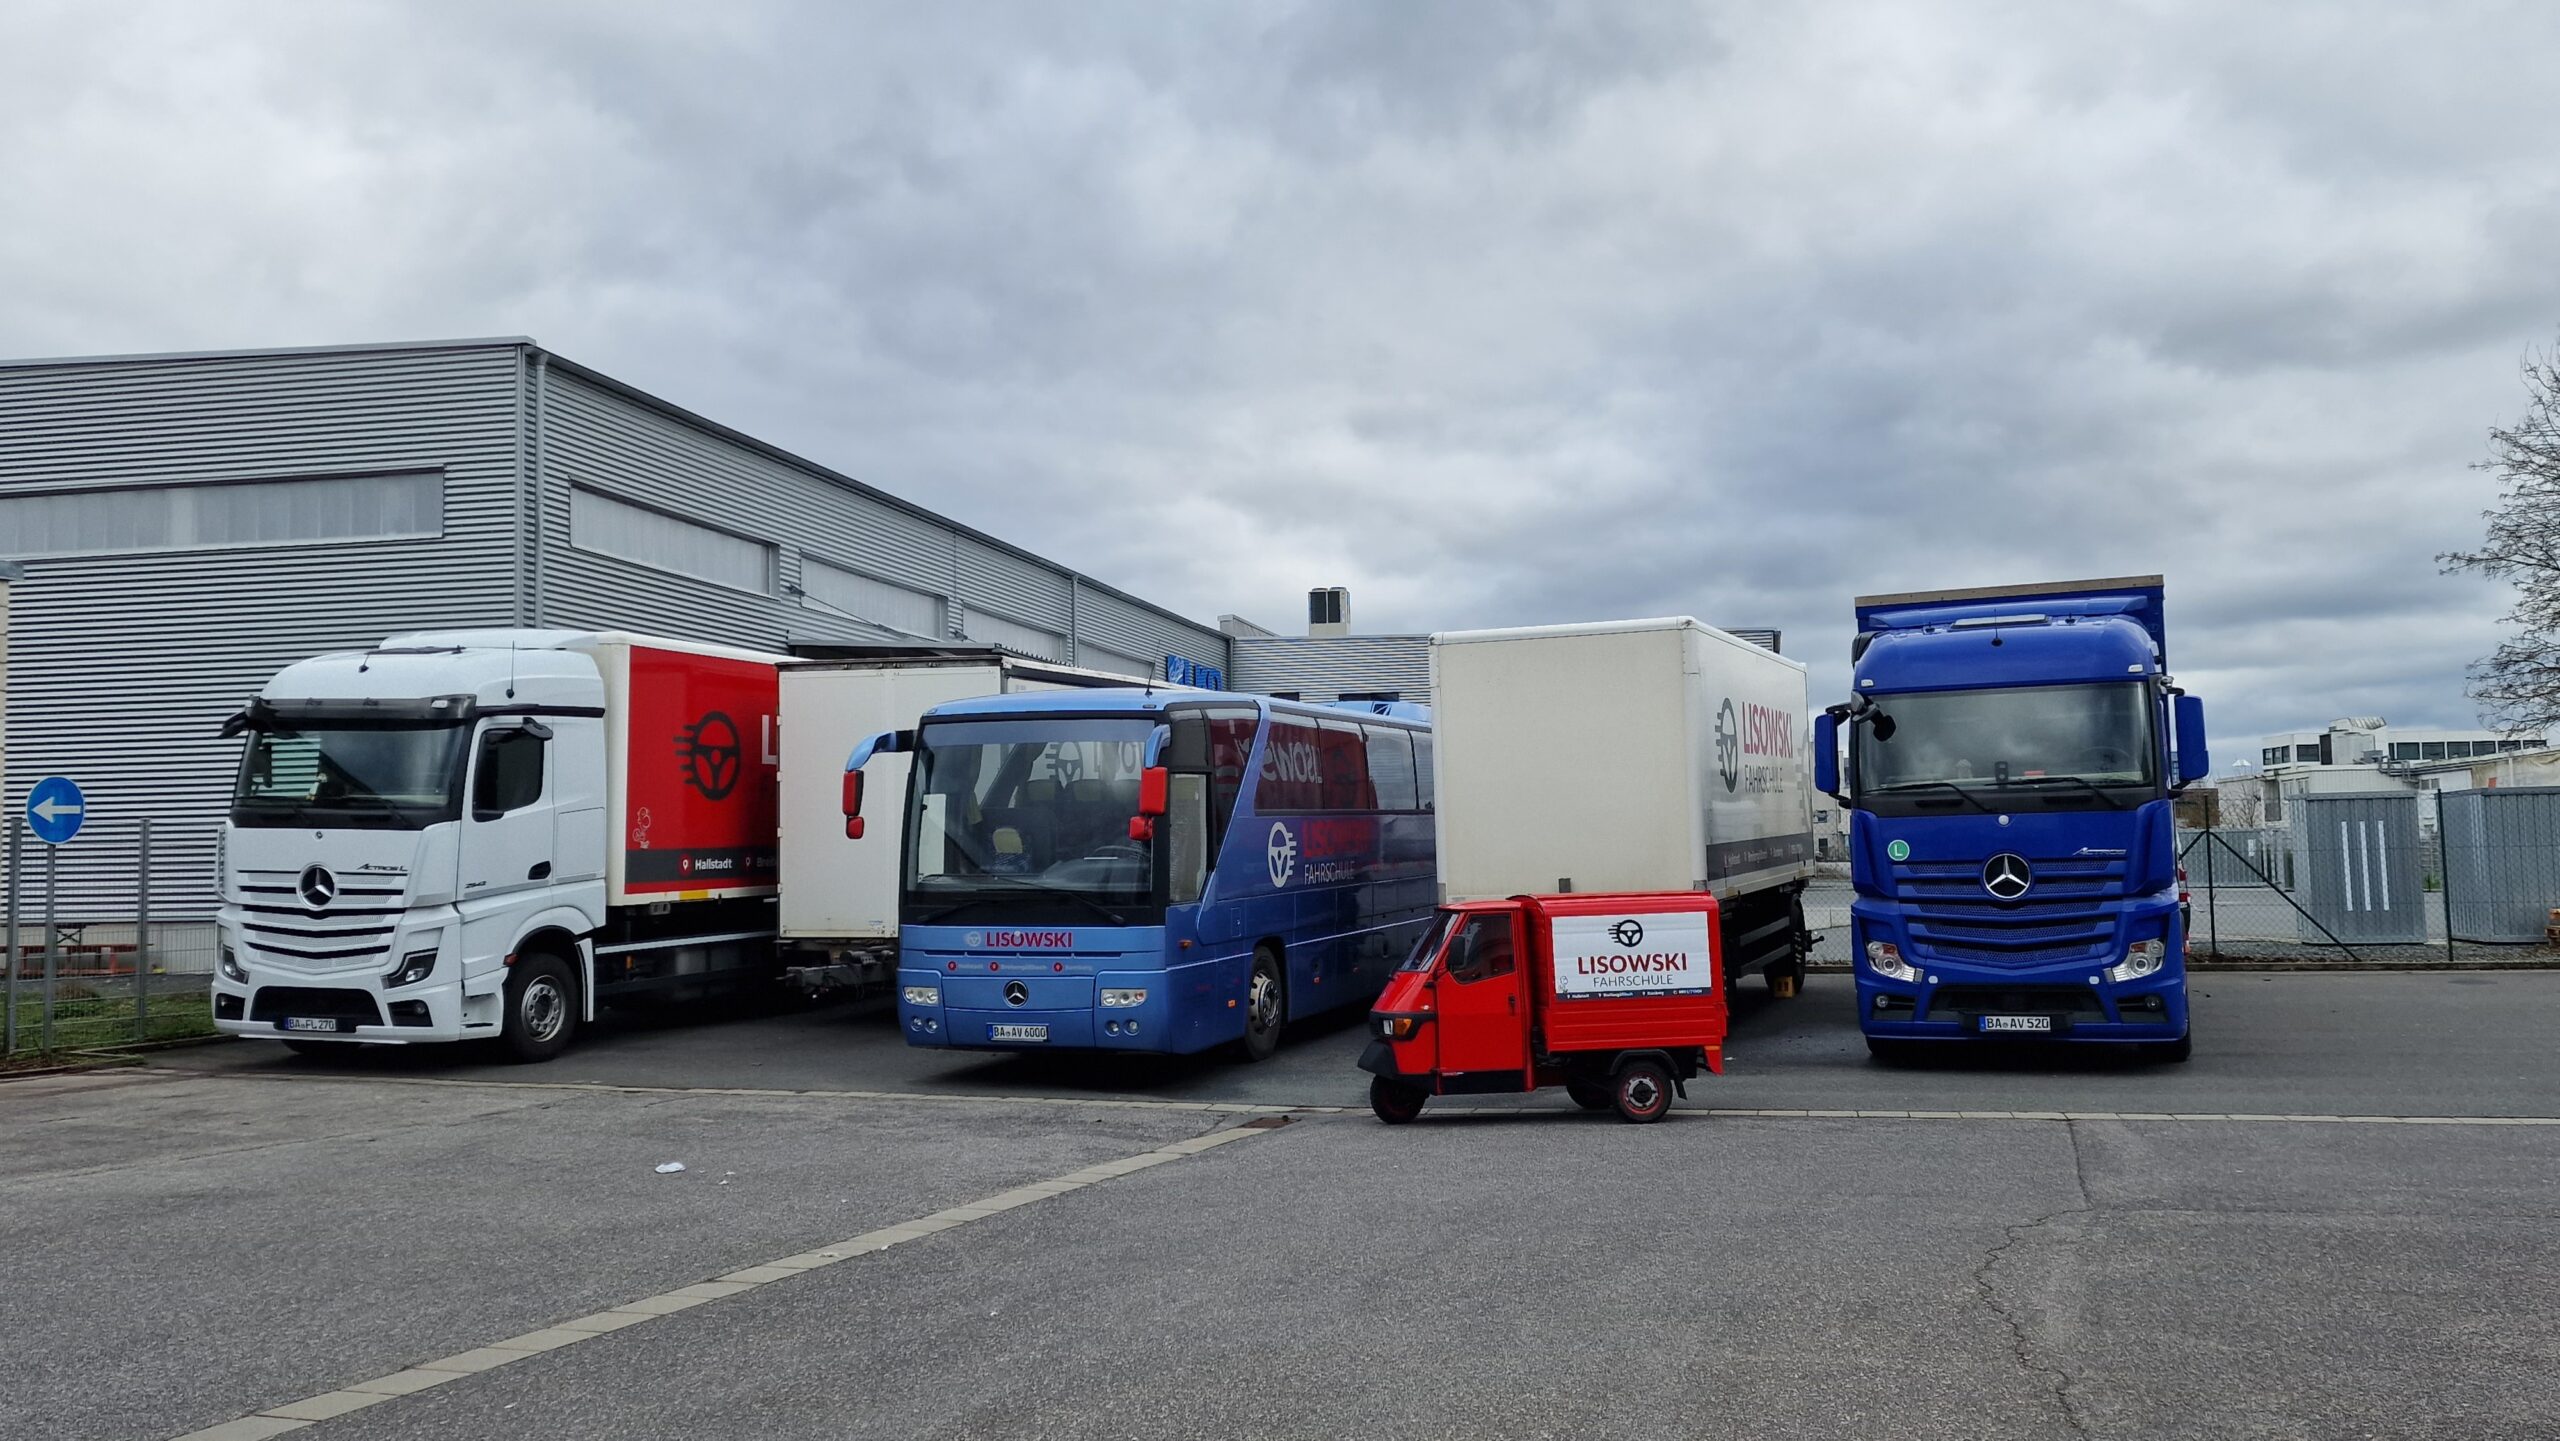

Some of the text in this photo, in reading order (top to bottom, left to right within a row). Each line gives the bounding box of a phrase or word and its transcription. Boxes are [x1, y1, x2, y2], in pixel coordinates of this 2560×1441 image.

[1742, 701, 1793, 759] LISOWSKI
[1744, 764, 1783, 793] FAHRSCHULE
[1894, 844, 1904, 856] L
[695, 858, 733, 870] Hallstadt
[1304, 860, 1355, 885] FAHRSCHULE
[986, 931, 1073, 948] LISOWSKI
[1578, 953, 1688, 975] LISOWSKI
[1593, 974, 1675, 988] FAHRSCHULE
[1987, 1018, 2049, 1029] BA AV 520
[1024, 1027, 1046, 1038] 6000
